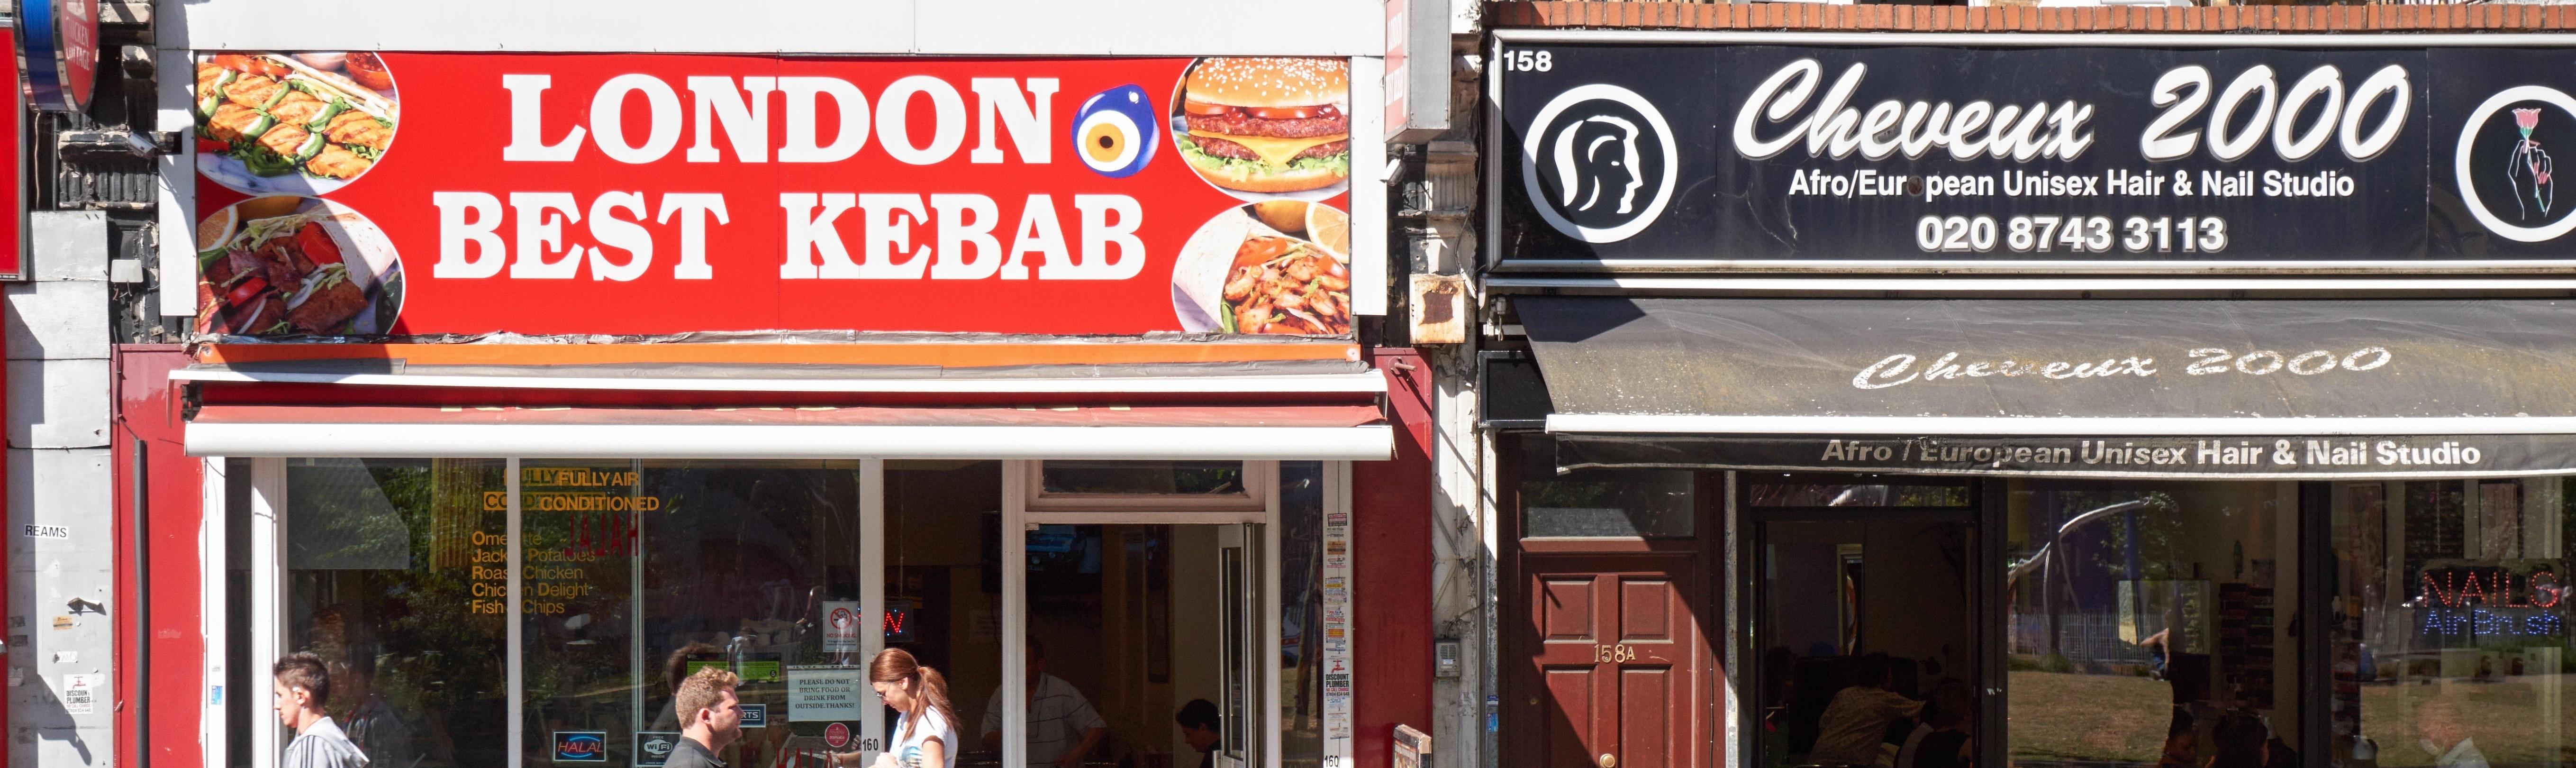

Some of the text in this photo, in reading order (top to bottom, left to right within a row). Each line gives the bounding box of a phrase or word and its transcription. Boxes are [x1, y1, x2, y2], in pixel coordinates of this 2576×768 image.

[1504, 50, 1552, 72] 158
[1732, 58, 2410, 162] Cheveux 2000
[502, 73, 1060, 165] LONDON
[1788, 169, 2354, 202] Afro/Eurpean Unisex Hair & Nail Studio
[433, 190, 1146, 282] BEST KEBAB
[1917, 215, 2228, 252] 020 8743 3113
[2186, 347, 2392, 376] 2000
[1821, 439, 1893, 462] Afro
[1919, 439, 2073, 467] European
[2082, 440, 2187, 466] Unisex
[2197, 440, 2263, 465] Hair
[2272, 439, 2296, 465] &
[2307, 440, 2367, 465] Nail
[2376, 440, 2481, 465] Studio
[559, 472, 610, 486] FULLY
[611, 472, 639, 486] AIR
[540, 496, 660, 511] CONDITIONED
[25, 525, 67, 538] REAMS
[472, 530, 542, 545] Omette
[472, 548, 507, 563] Jack
[472, 565, 583, 580] Roas Chicken
[472, 582, 589, 599] Chicn Delight
[2423, 571, 2558, 608] NAILS
[472, 599, 565, 616] Fish Chips
[1594, 644, 1636, 663] 158A
[558, 742, 604, 752] HALAL
[862, 738, 879, 751] 160
[1324, 755, 1339, 768] 160
